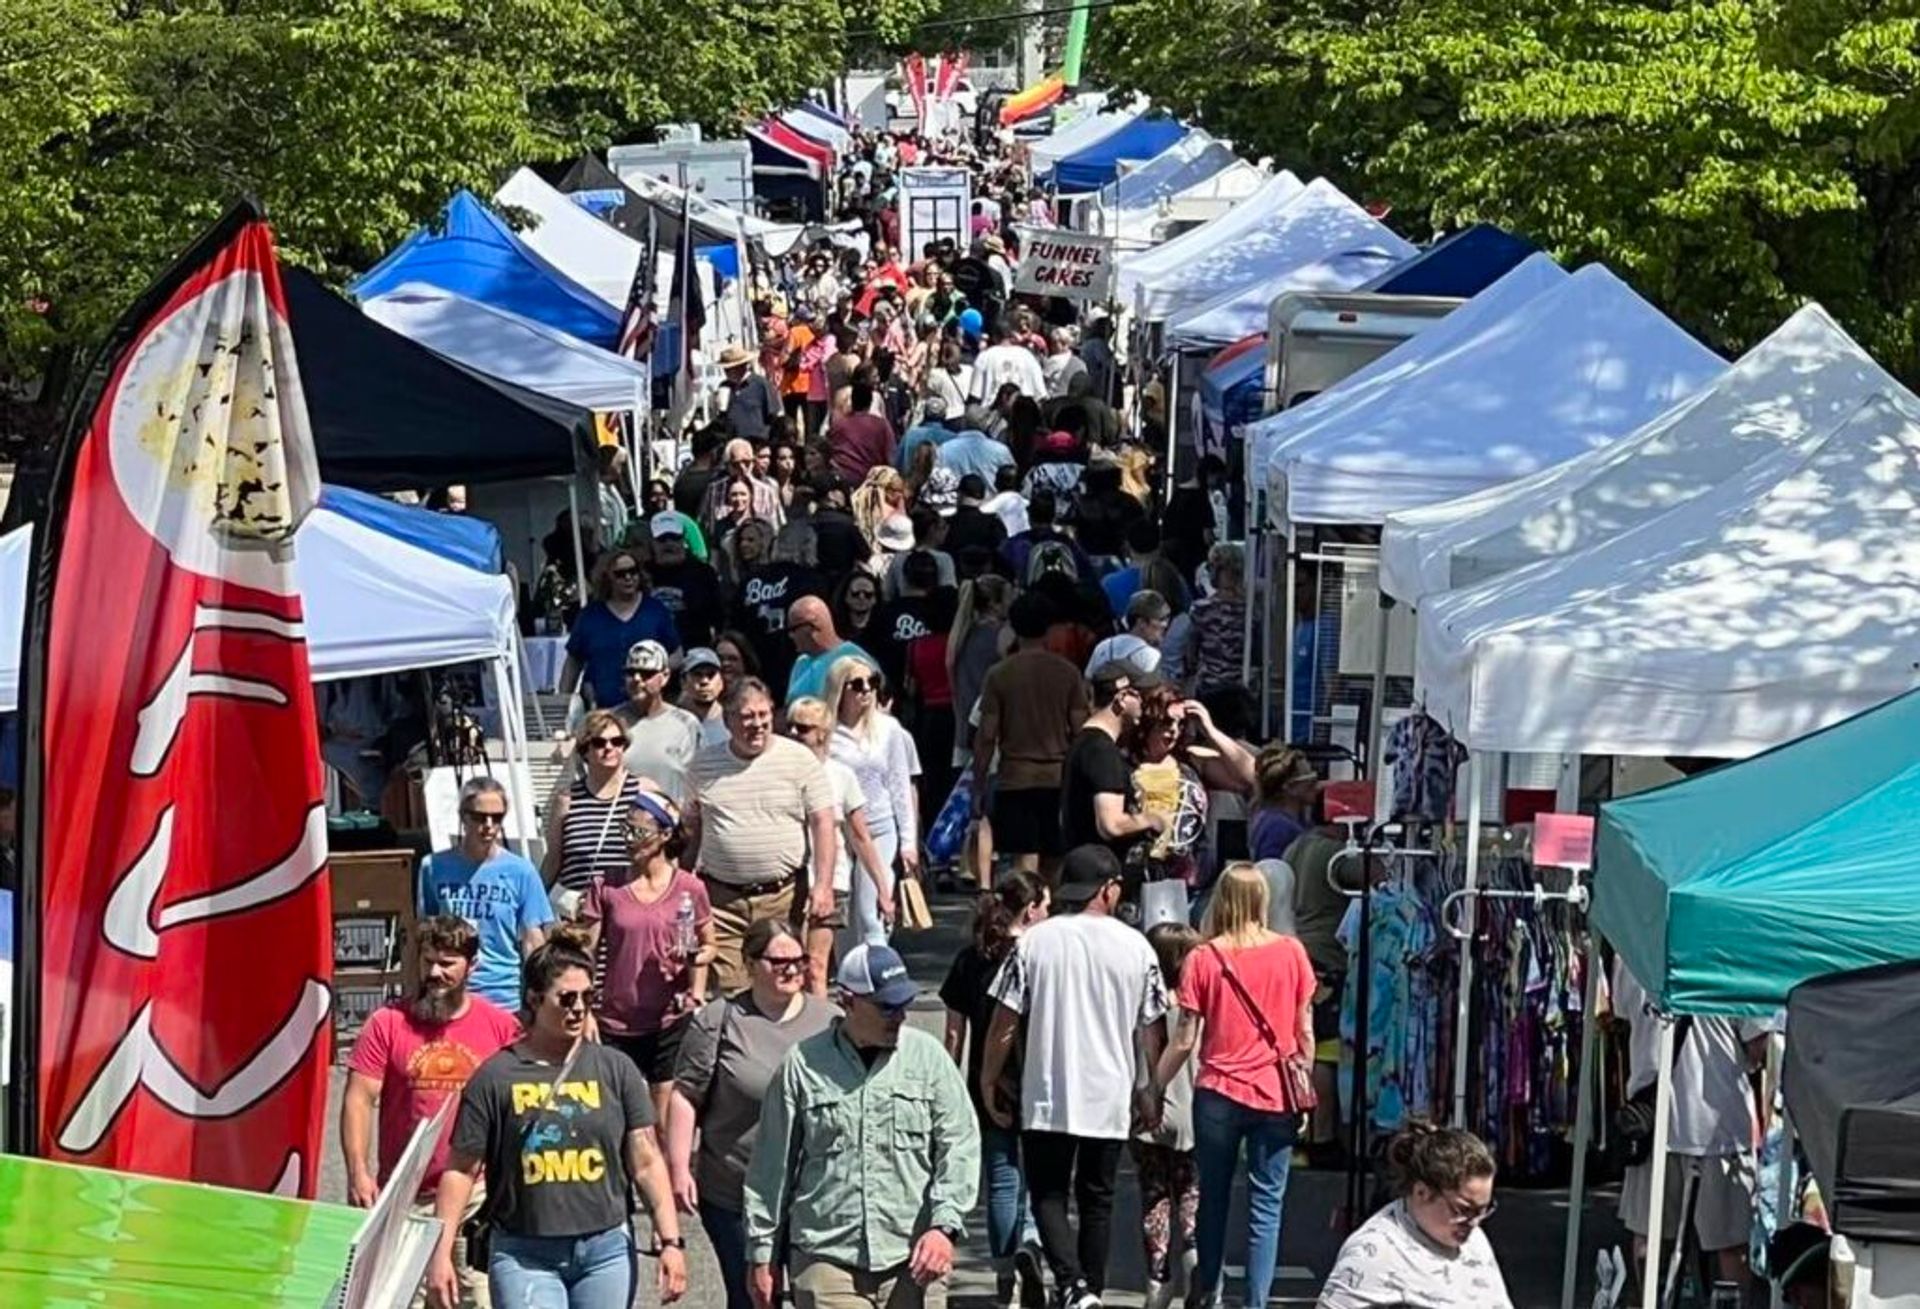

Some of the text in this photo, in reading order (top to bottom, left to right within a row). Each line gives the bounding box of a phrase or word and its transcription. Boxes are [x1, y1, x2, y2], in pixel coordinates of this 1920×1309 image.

[1028, 241, 1102, 265] FUNNEL
[1034, 266, 1094, 287] CAKES
[745, 576, 789, 604] Bad
[893, 613, 931, 640] Ba
[437, 882, 511, 904] CHAPEL
[451, 899, 496, 920] HILL
[521, 1148, 606, 1185] DMC
